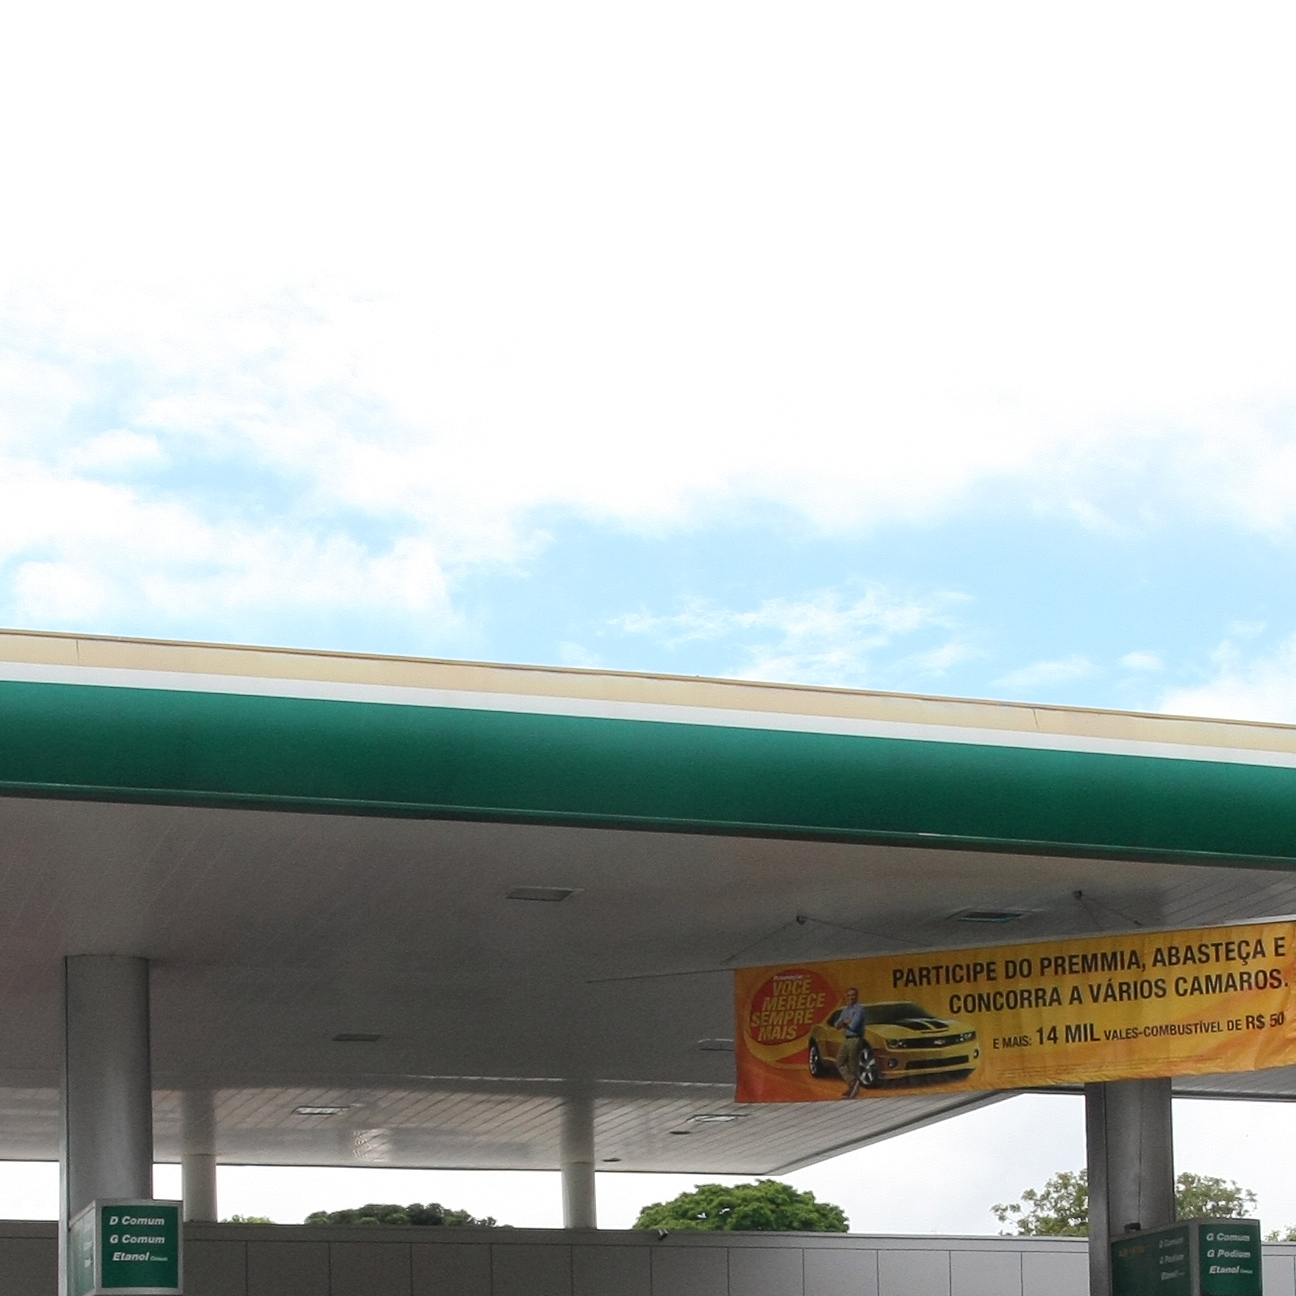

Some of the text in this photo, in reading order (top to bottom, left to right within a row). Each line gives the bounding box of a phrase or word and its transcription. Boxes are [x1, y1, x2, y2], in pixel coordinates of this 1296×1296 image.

[892, 937, 1286, 988] PARTICIPE DO PREMMIA, ABASTEÇA E
[949, 968, 1289, 1014] CONCORRA A VÁRIOS CAMAROS.
[762, 993, 825, 1011] MERECE
[751, 1009, 813, 1027] SEMPRE
[757, 1025, 797, 1041] MAIS
[993, 1011, 1284, 1049] E MAIS: 14 MIL VALES-COMBUSTÍVEL DE R$ 50
[109, 1216, 165, 1225] D Comum
[110, 1234, 165, 1244] G Comum
[1206, 1233, 1250, 1241] G Comum
[112, 1252, 150, 1262] Etanol
[1206, 1249, 1251, 1258] G Podium
[1209, 1265, 1240, 1274] Etanol
